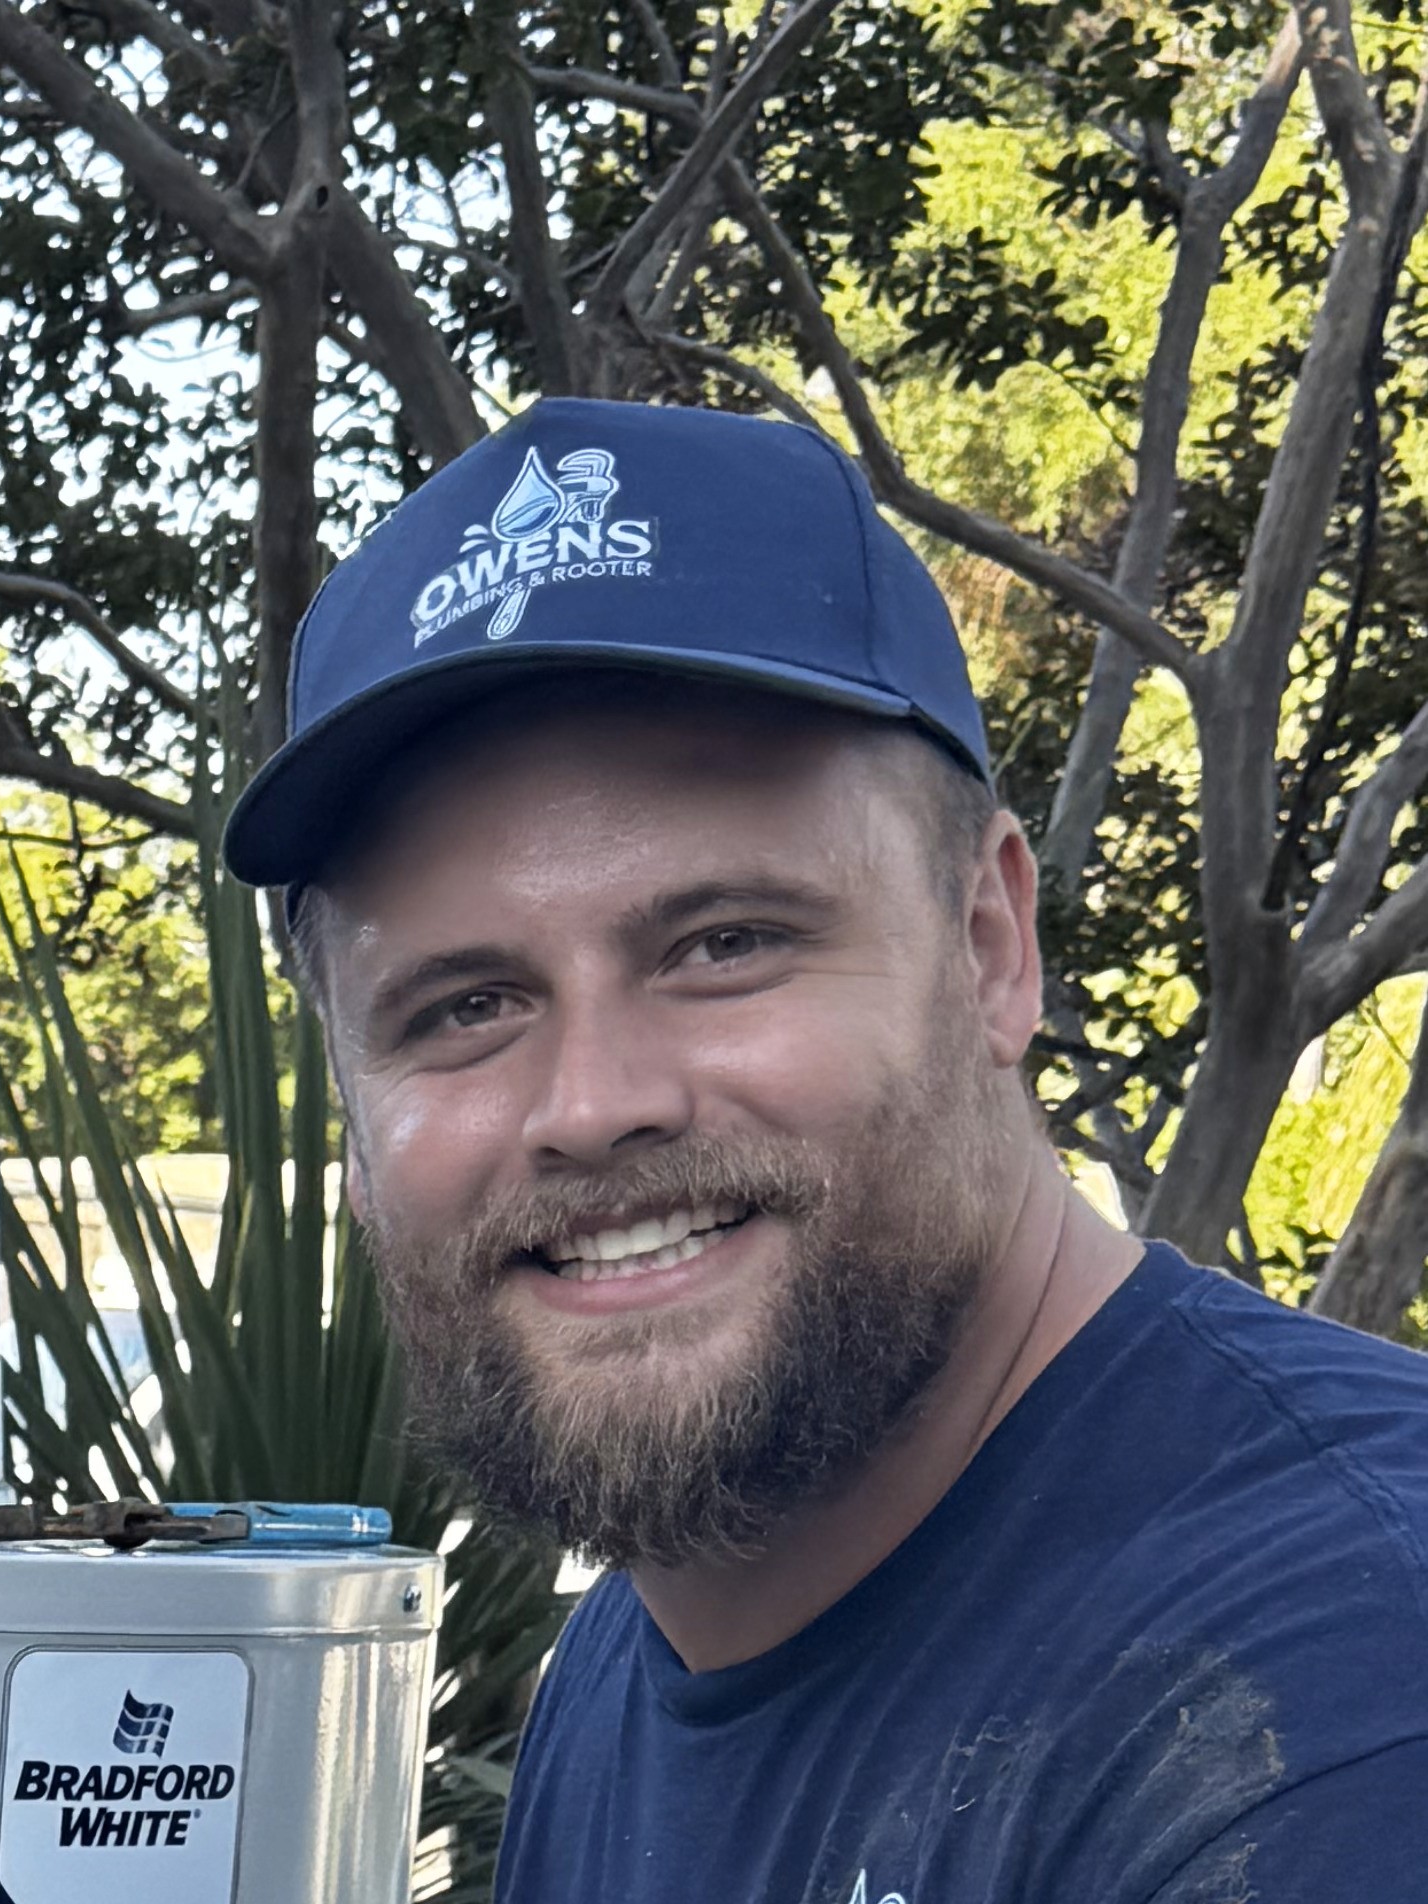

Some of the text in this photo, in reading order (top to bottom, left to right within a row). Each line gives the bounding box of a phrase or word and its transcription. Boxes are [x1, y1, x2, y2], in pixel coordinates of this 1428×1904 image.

[409, 519, 652, 625] OWENS
[528, 571, 546, 588] &
[552, 560, 652, 583] ROOTER
[13, 1761, 235, 1801] BRADFORD
[59, 1807, 192, 1847] WHITE
